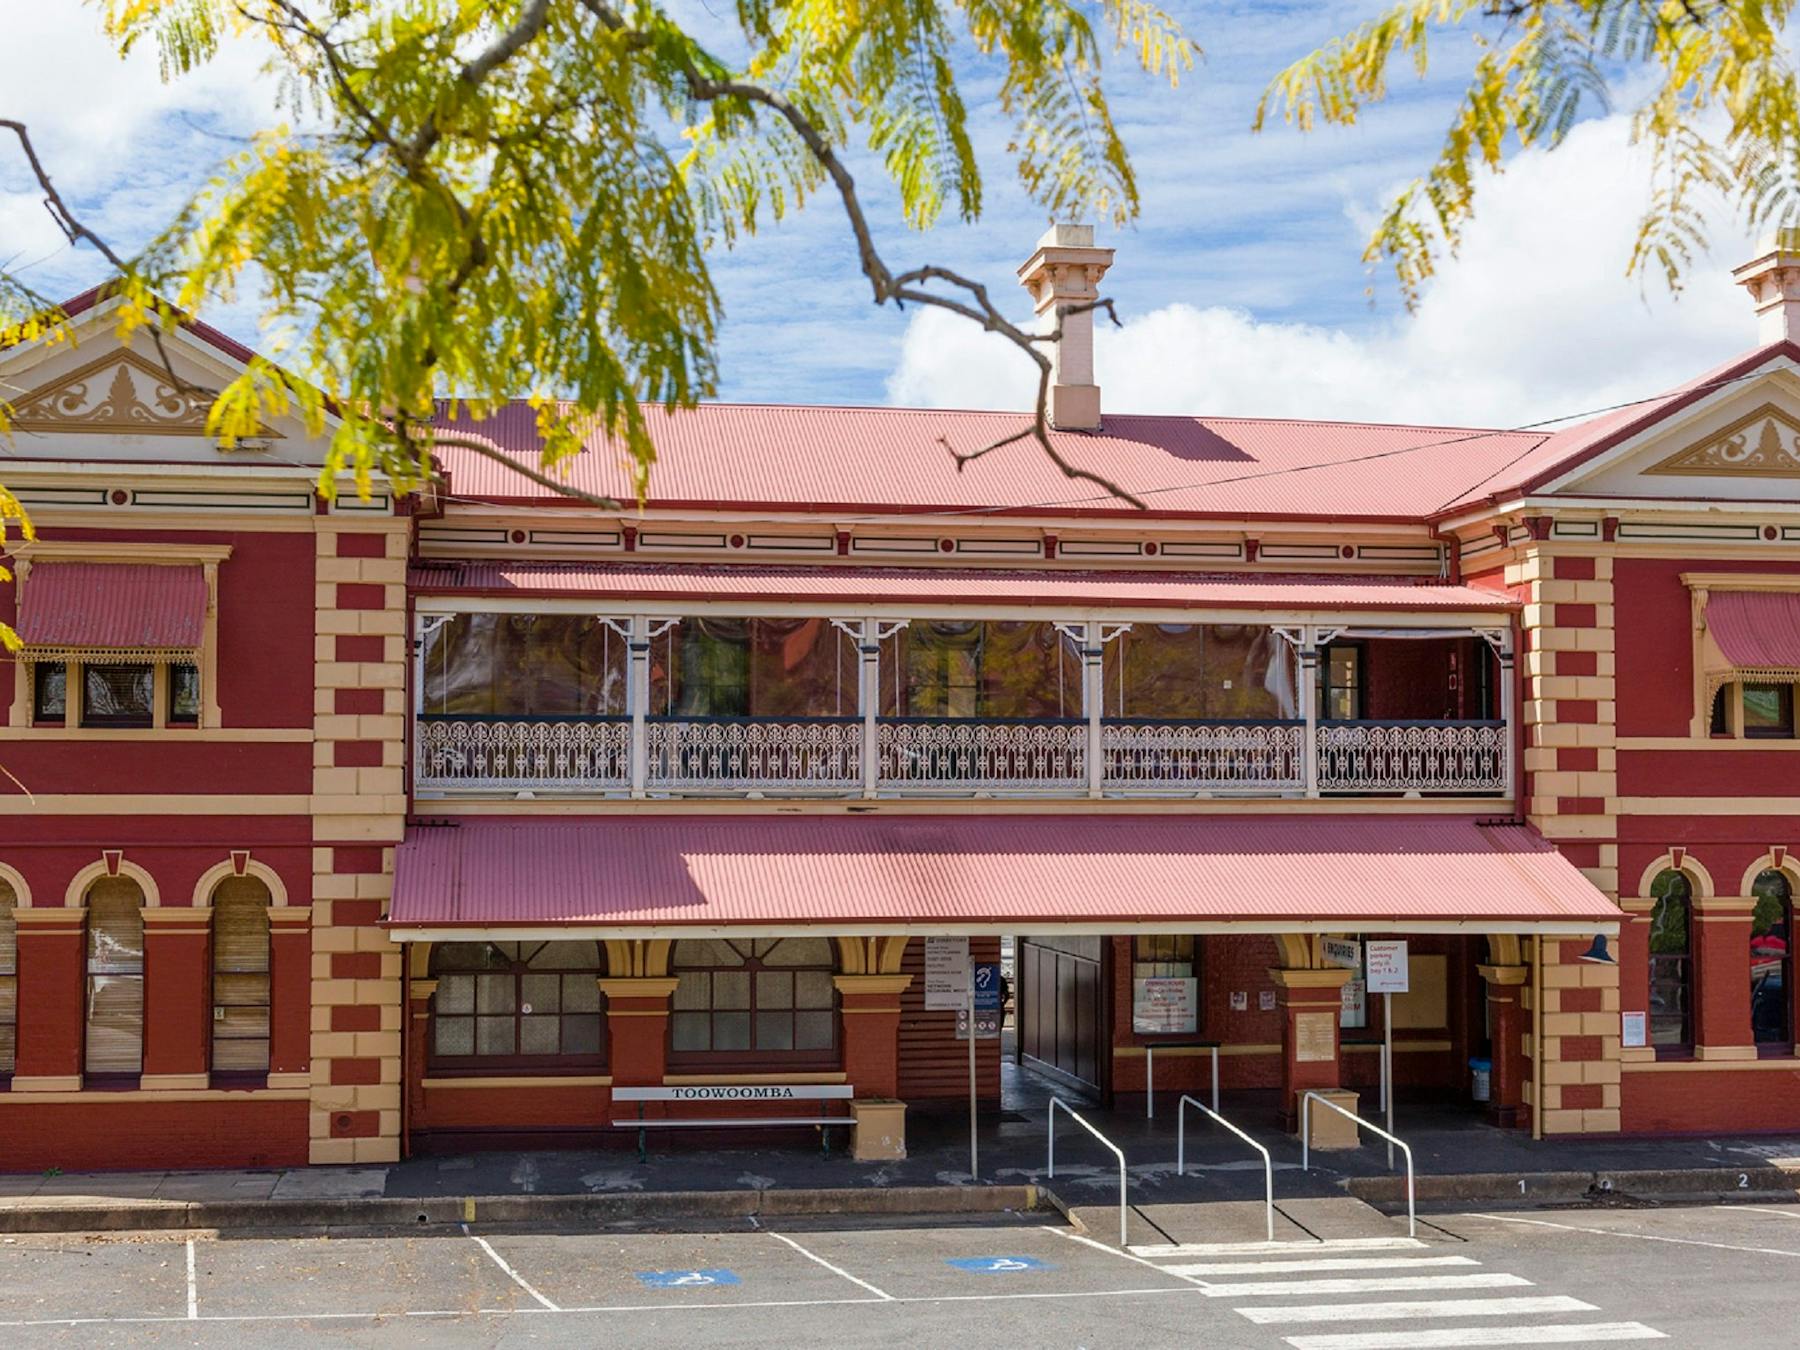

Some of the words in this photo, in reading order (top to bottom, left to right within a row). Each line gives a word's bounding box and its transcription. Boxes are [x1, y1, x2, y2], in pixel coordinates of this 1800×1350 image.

[1328, 942, 1354, 960] ENQUIRIES
[672, 1087, 793, 1099] TOOWOOMBA
[1518, 1180, 1525, 1194] 1
[1739, 1173, 1748, 1187] 2
